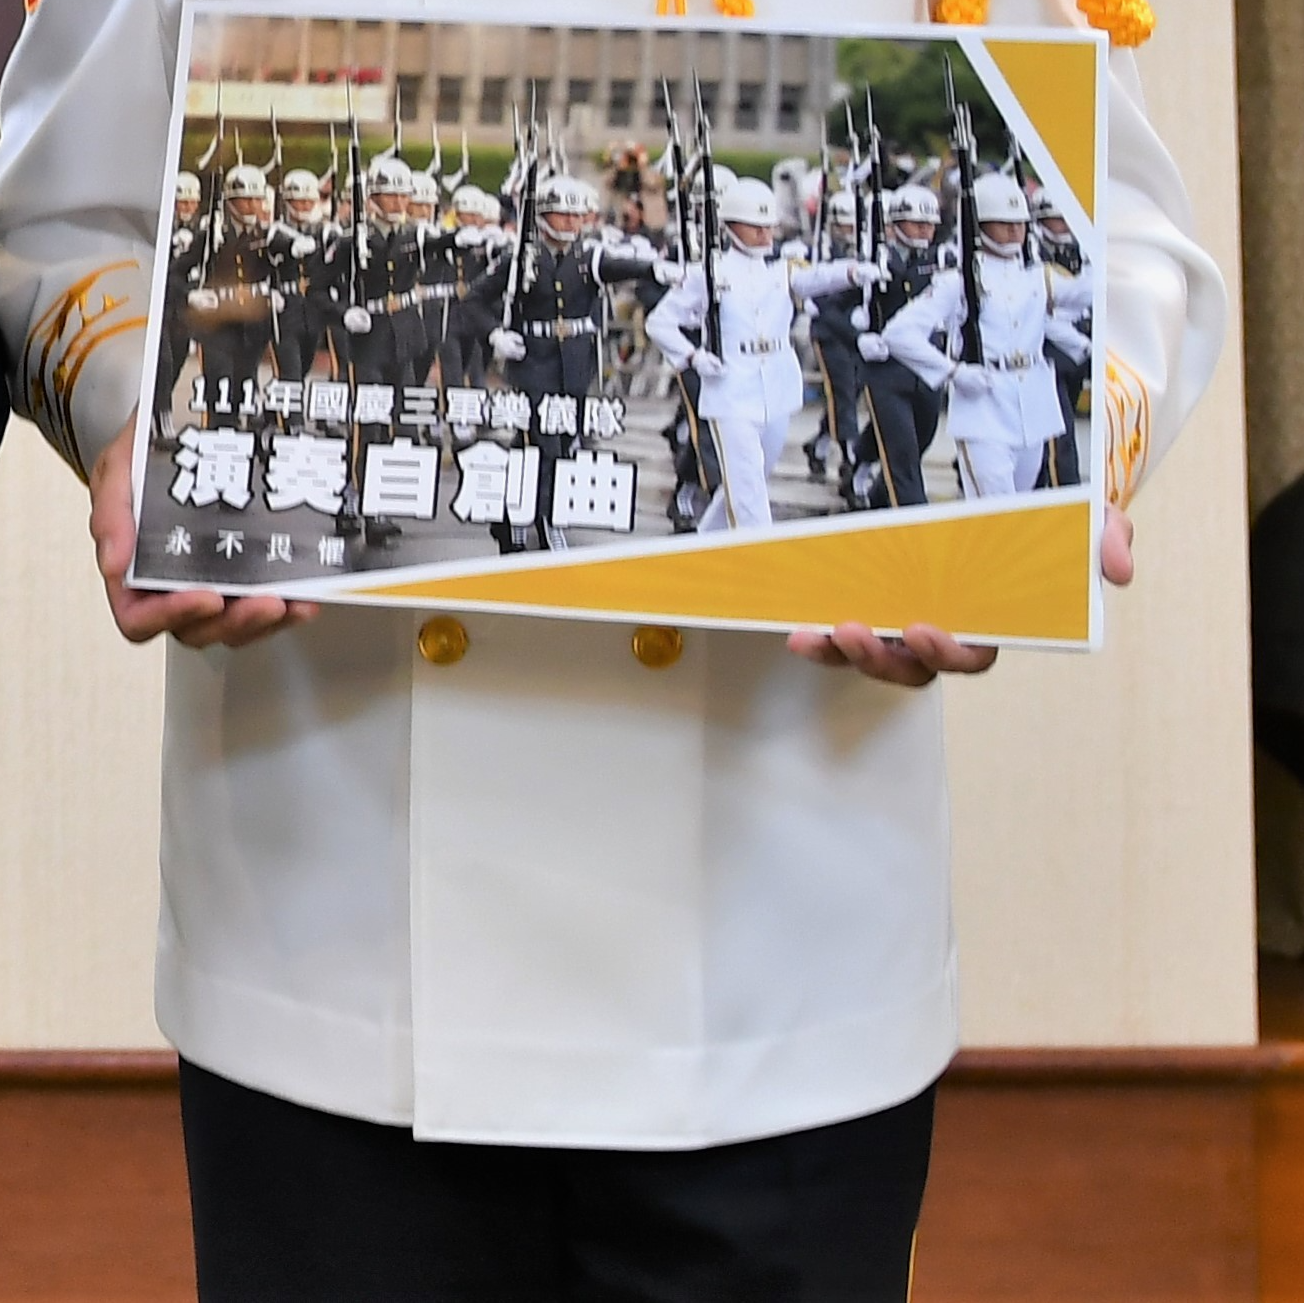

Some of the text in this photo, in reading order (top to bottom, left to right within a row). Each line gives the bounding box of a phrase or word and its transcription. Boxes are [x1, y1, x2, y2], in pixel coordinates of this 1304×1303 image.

[190, 376, 626, 437] 111年國慶三軍樂儀隊
[170, 426, 637, 532] 演奏自創曲
